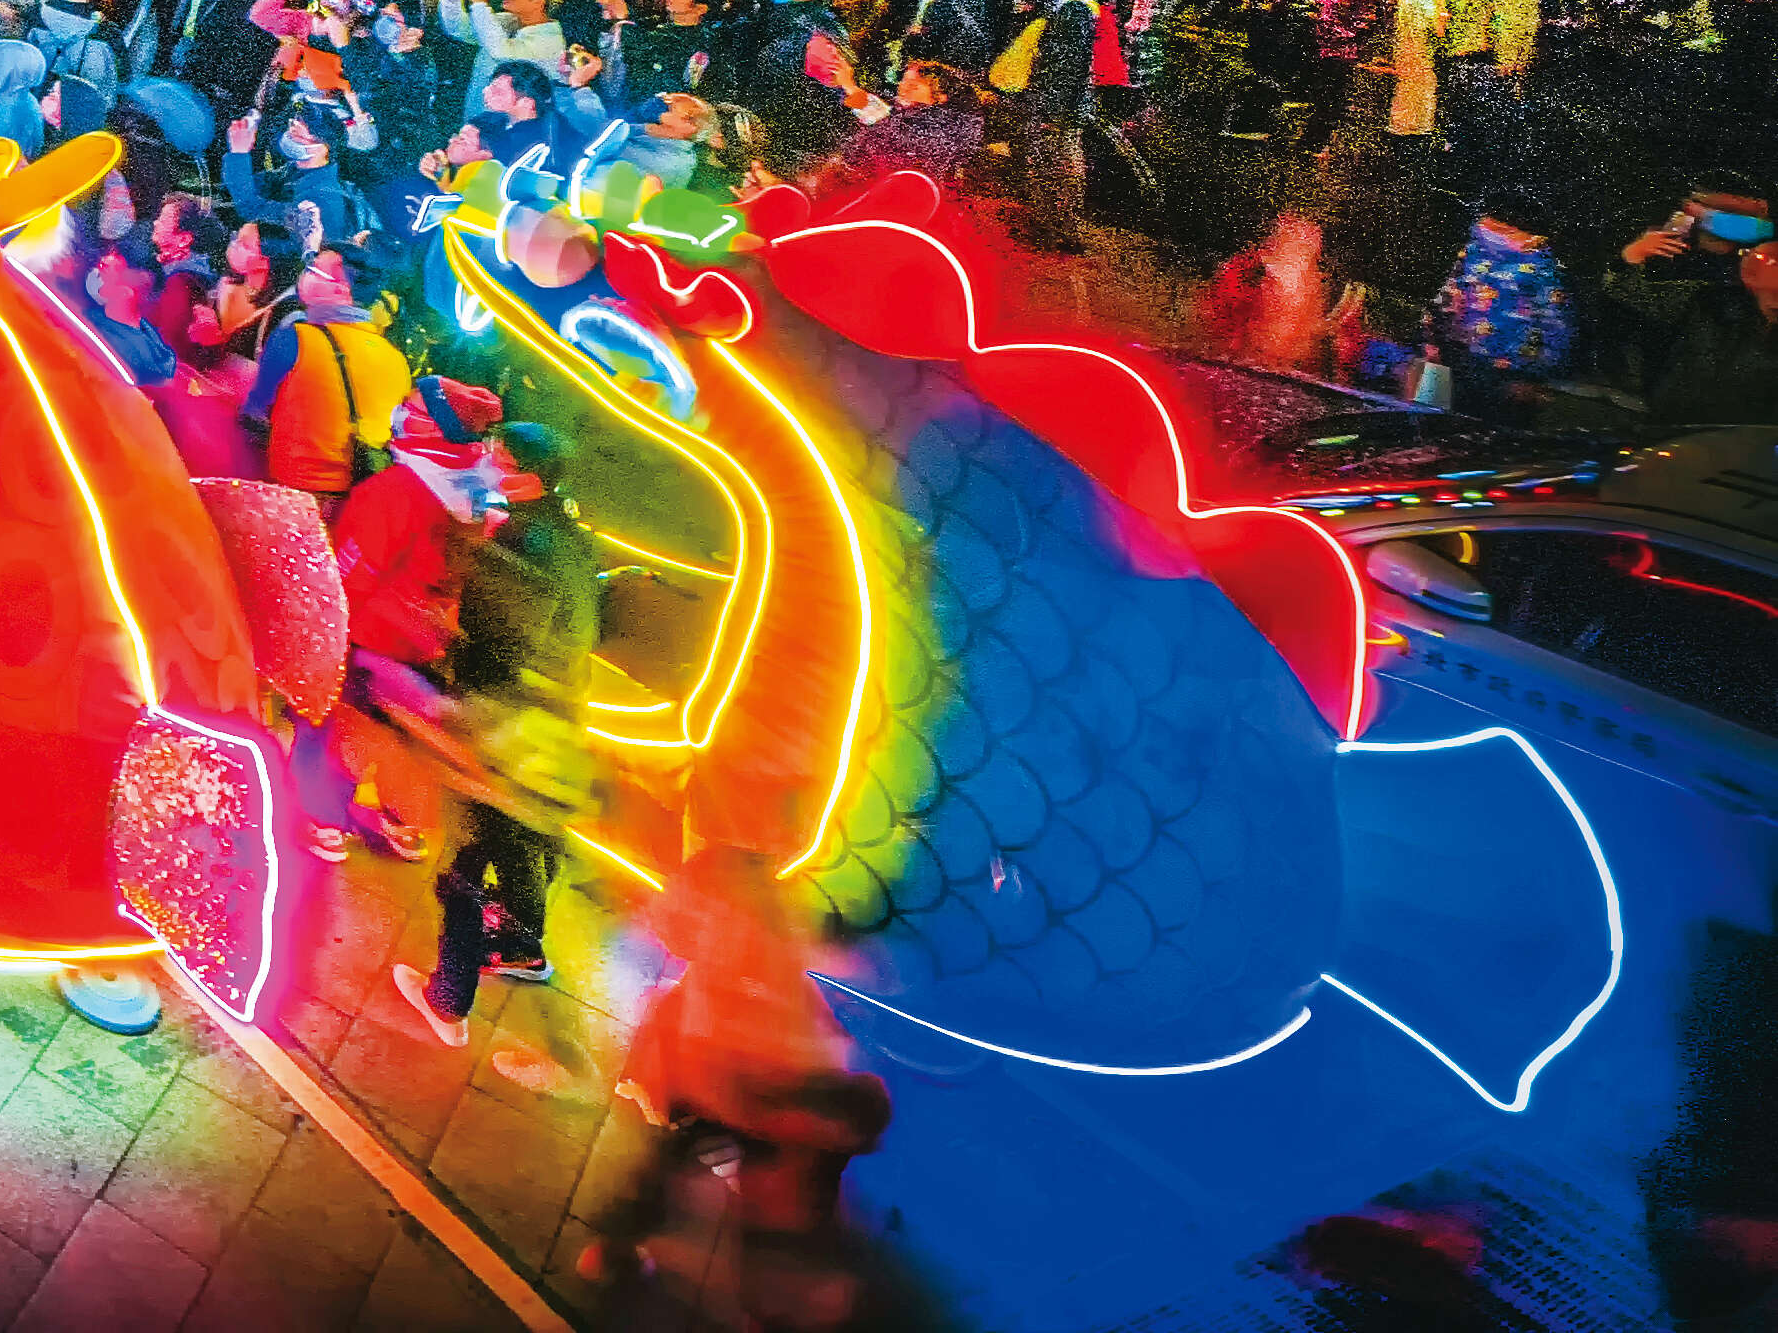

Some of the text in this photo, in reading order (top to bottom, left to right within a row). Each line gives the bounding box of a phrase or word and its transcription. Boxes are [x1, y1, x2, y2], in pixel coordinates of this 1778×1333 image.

[1399, 641, 1657, 760] 北市政府警察局
